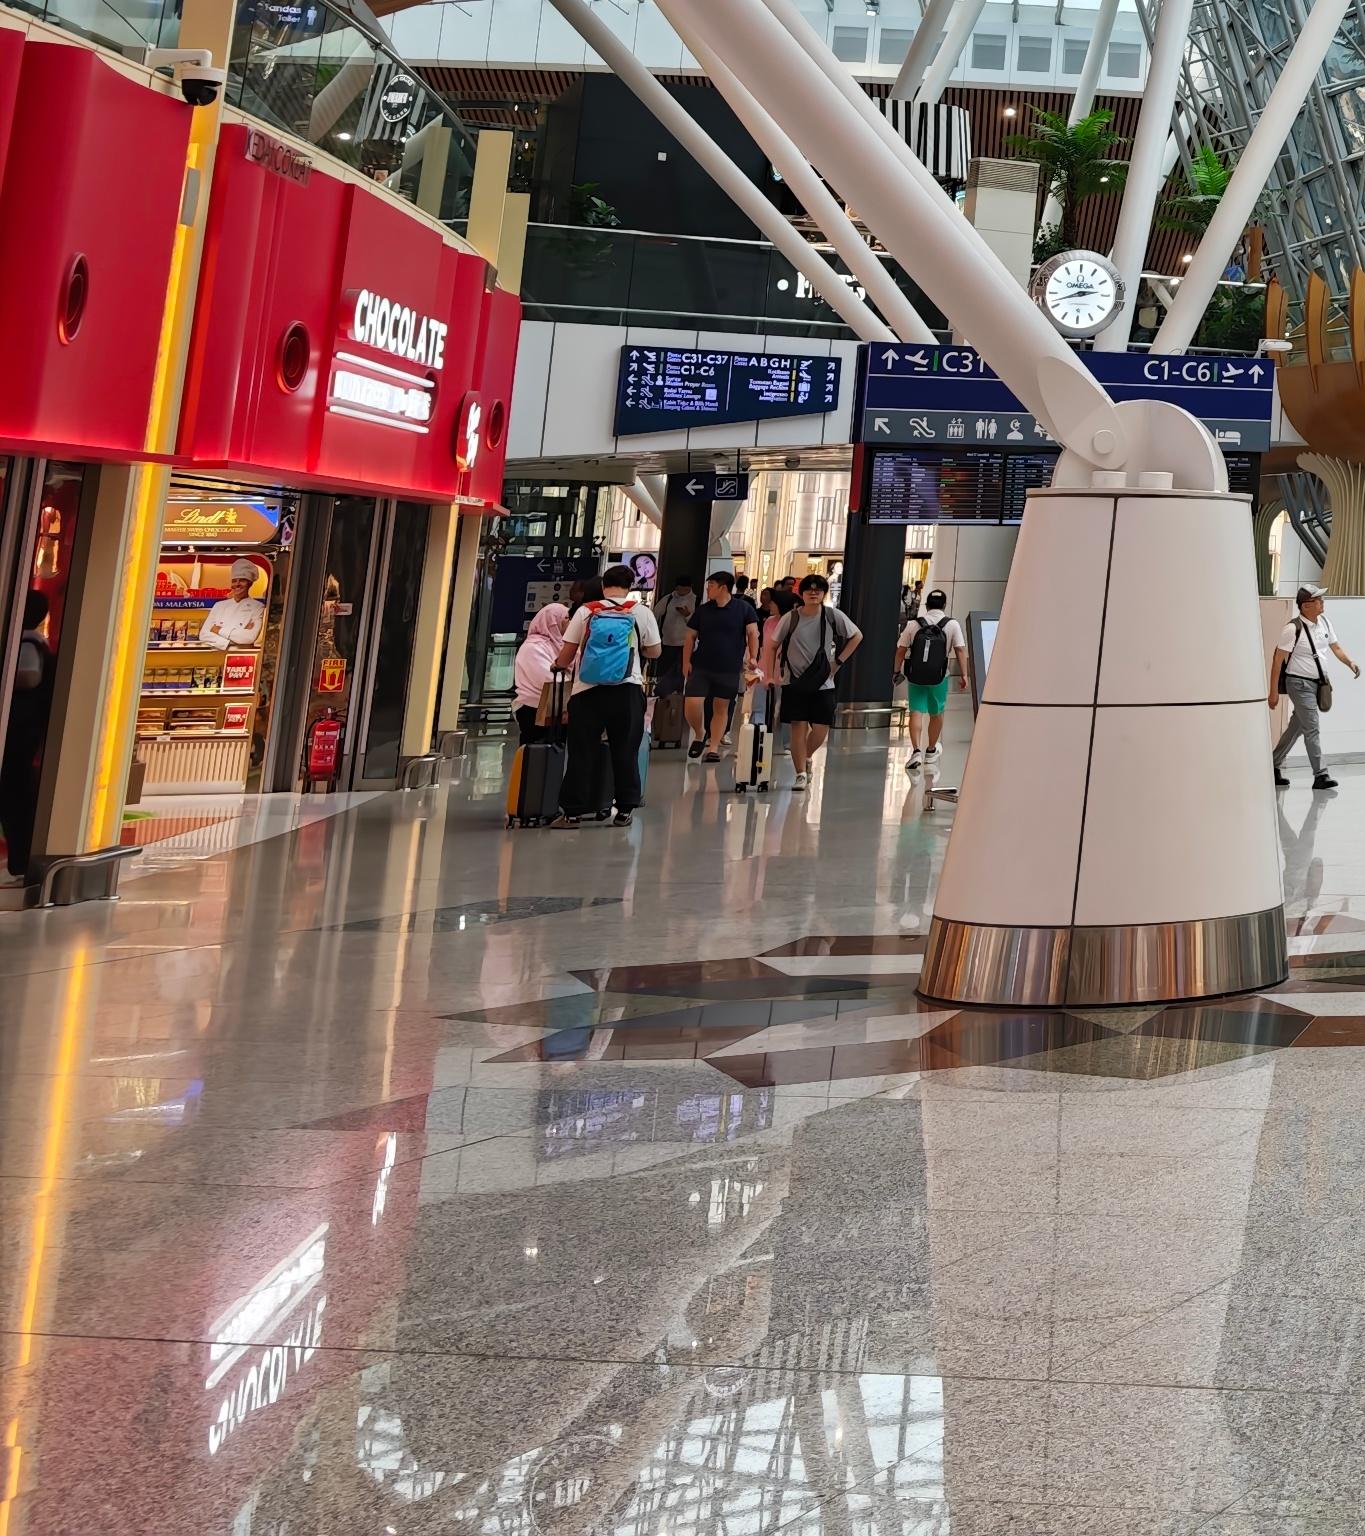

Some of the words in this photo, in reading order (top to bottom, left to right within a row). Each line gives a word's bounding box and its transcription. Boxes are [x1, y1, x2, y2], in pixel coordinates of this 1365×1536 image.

[354, 289, 447, 369] CHOCOLATE
[682, 353, 728, 364] C31-C37
[749, 357, 758, 367] A
[760, 358, 768, 367] B
[770, 358, 779, 368] G
[781, 359, 790, 368] H
[681, 365, 714, 376] C1-C6
[1144, 360, 1211, 382] C1-C6
[174, 508, 226, 524] Lindt
